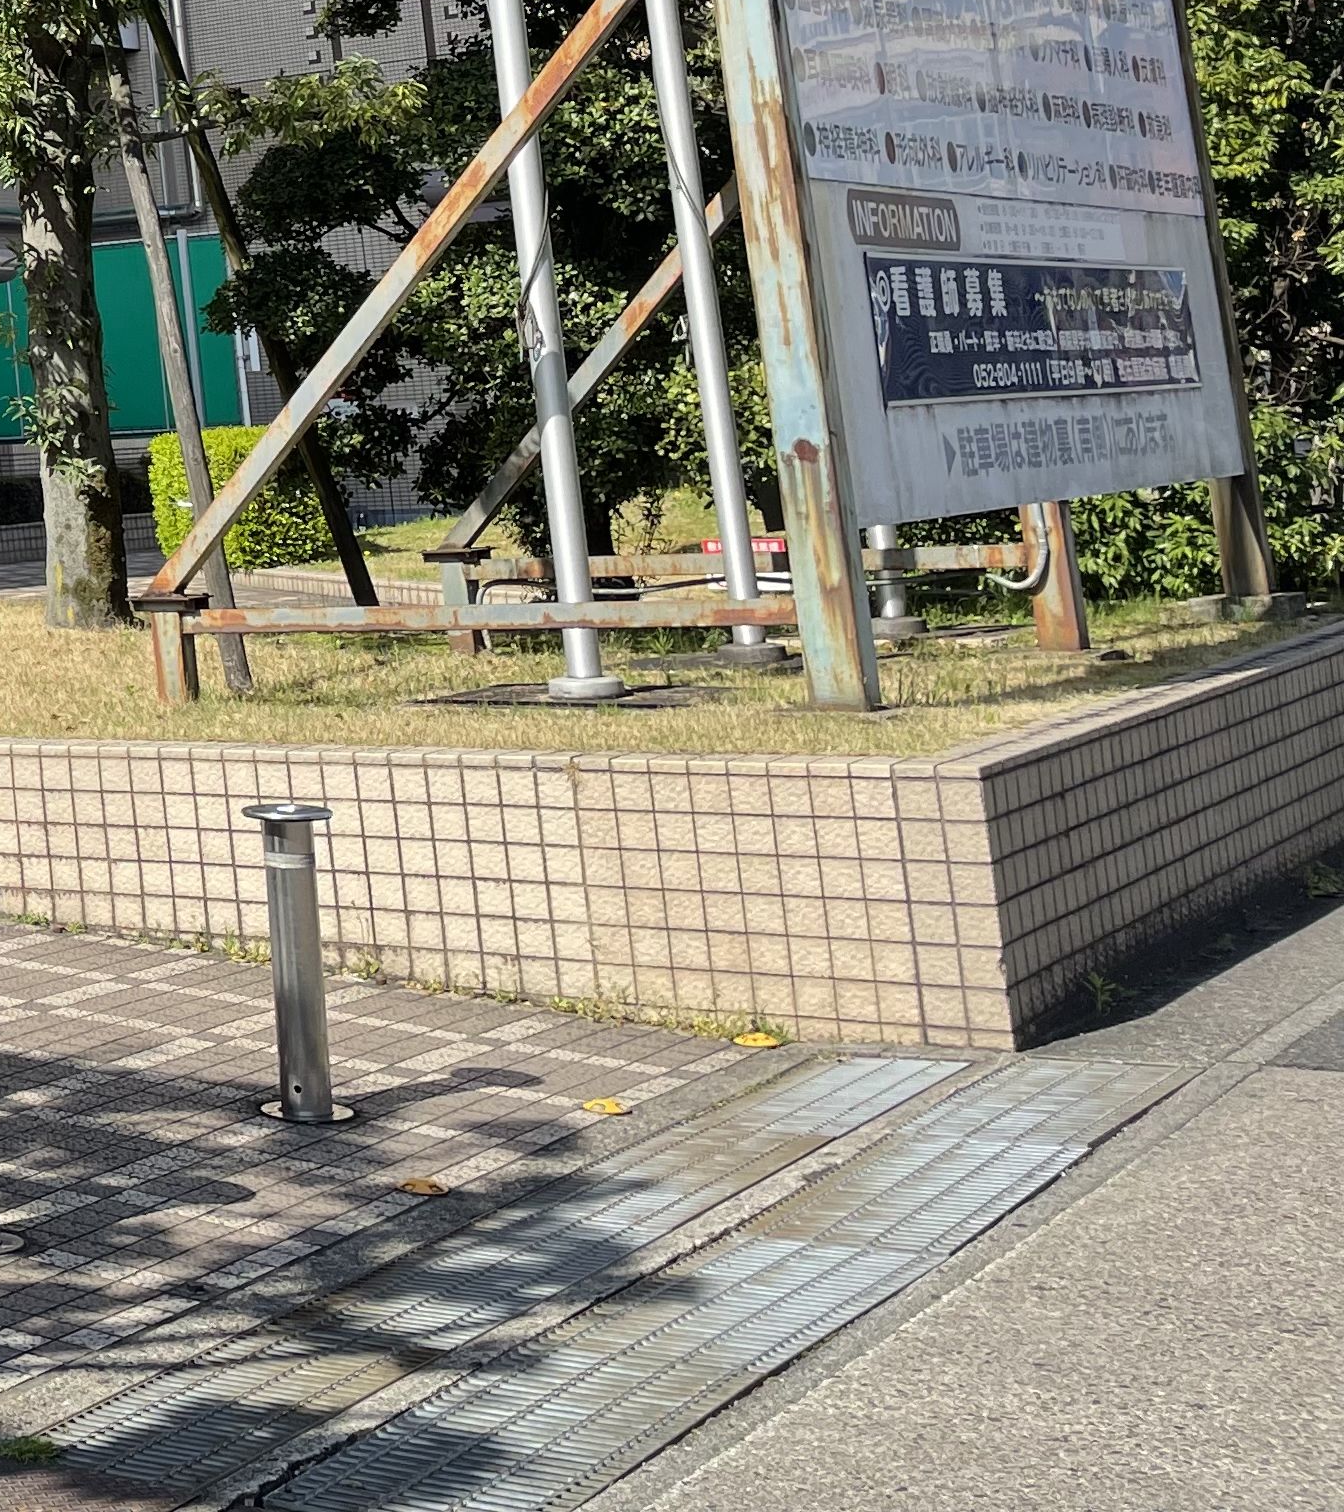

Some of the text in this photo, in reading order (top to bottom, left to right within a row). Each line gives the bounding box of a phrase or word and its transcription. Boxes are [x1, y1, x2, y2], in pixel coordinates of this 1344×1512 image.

[815, 120, 882, 164] 神経精神科
[893, 131, 944, 171] 形成外科
[954, 139, 1016, 179] アレルギー科
[851, 199, 957, 243] INFORMATION
[890, 266, 1007, 317] 看護師募集
